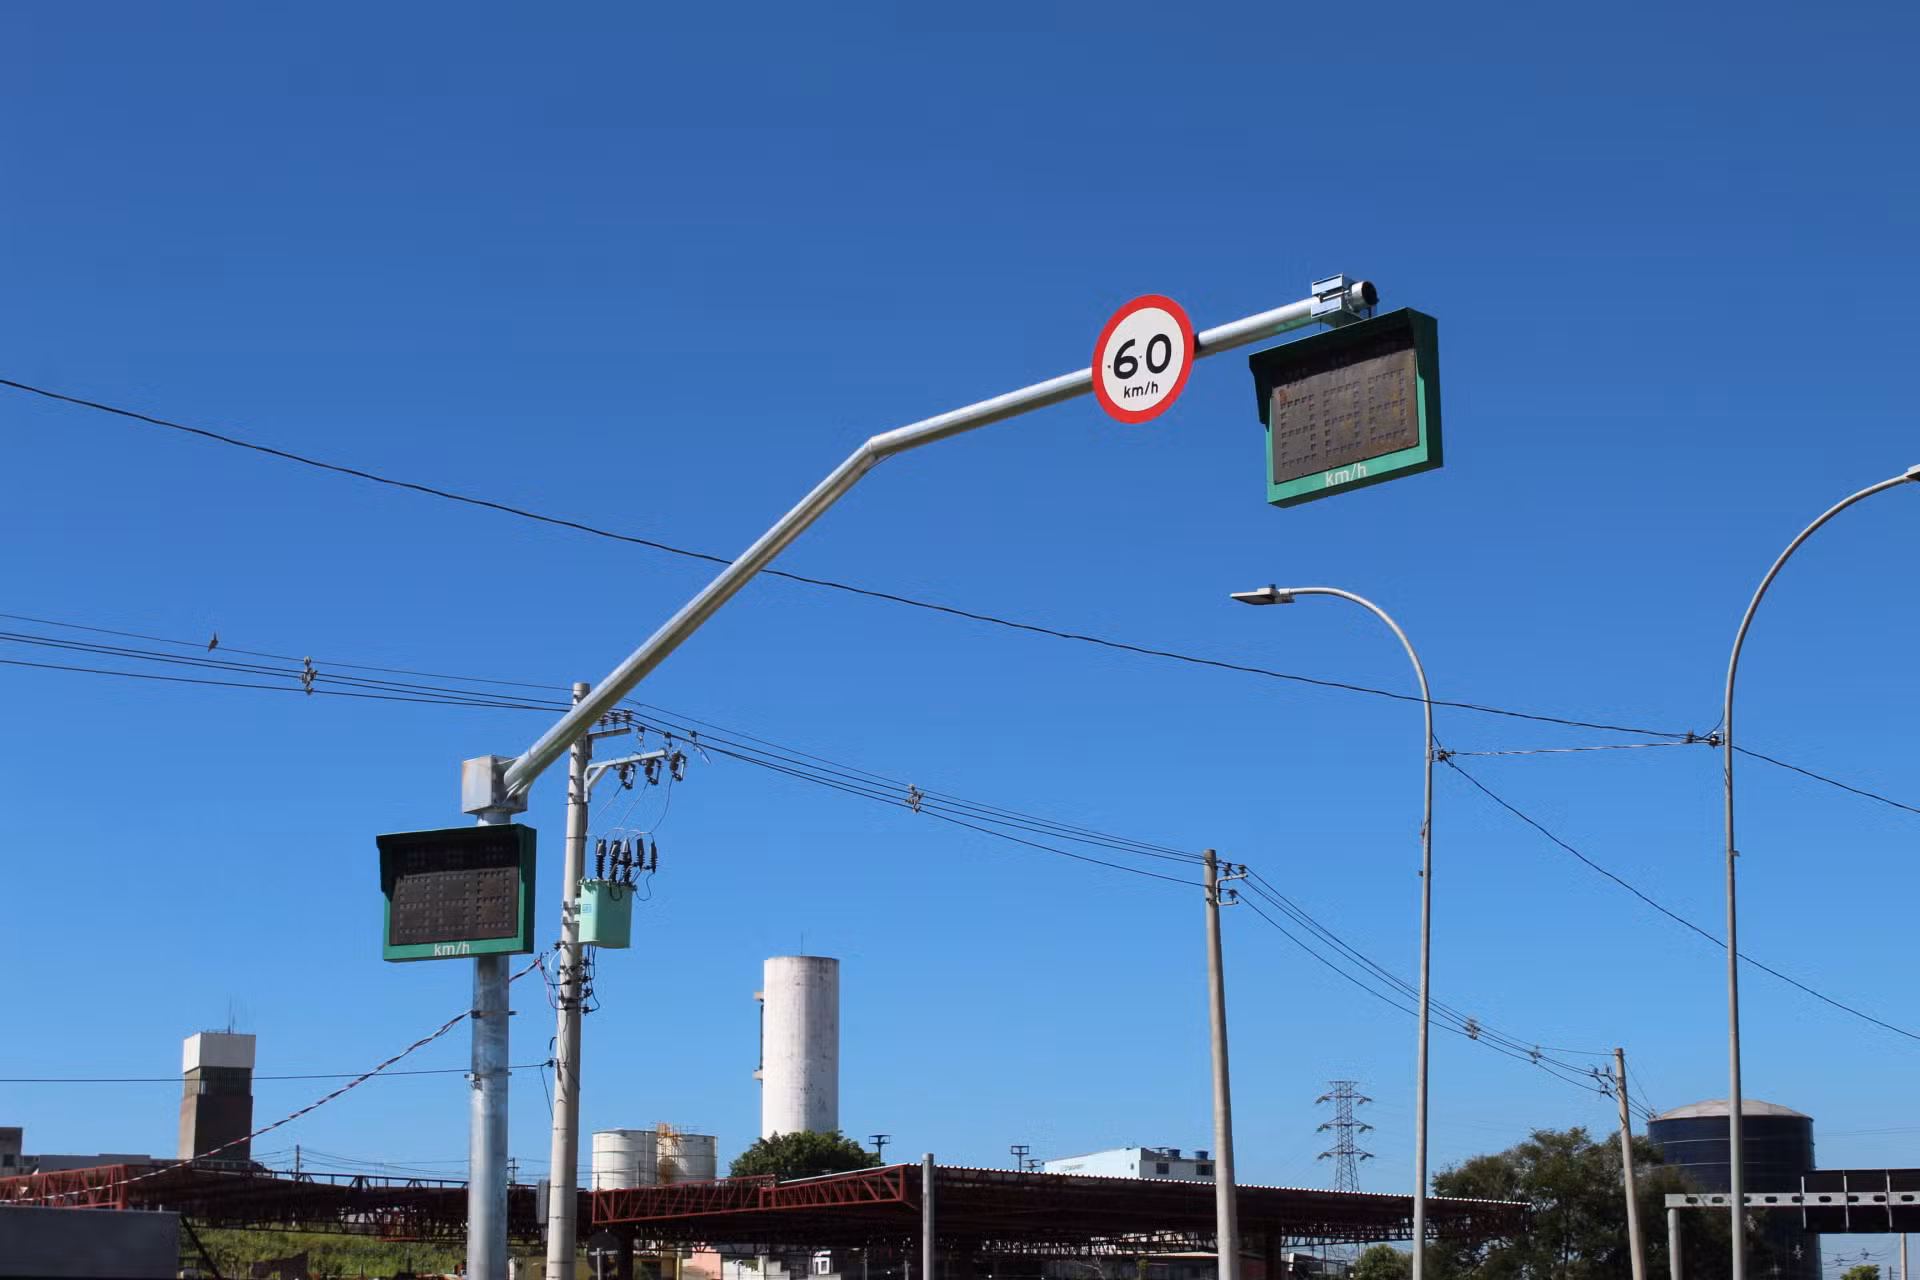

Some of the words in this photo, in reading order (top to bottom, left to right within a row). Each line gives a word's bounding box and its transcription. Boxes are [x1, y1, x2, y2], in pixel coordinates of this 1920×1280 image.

[1113, 333, 1172, 380] 60
[1123, 381, 1159, 399] km/h
[1324, 463, 1368, 487] km/h
[434, 941, 470, 957] km/h
